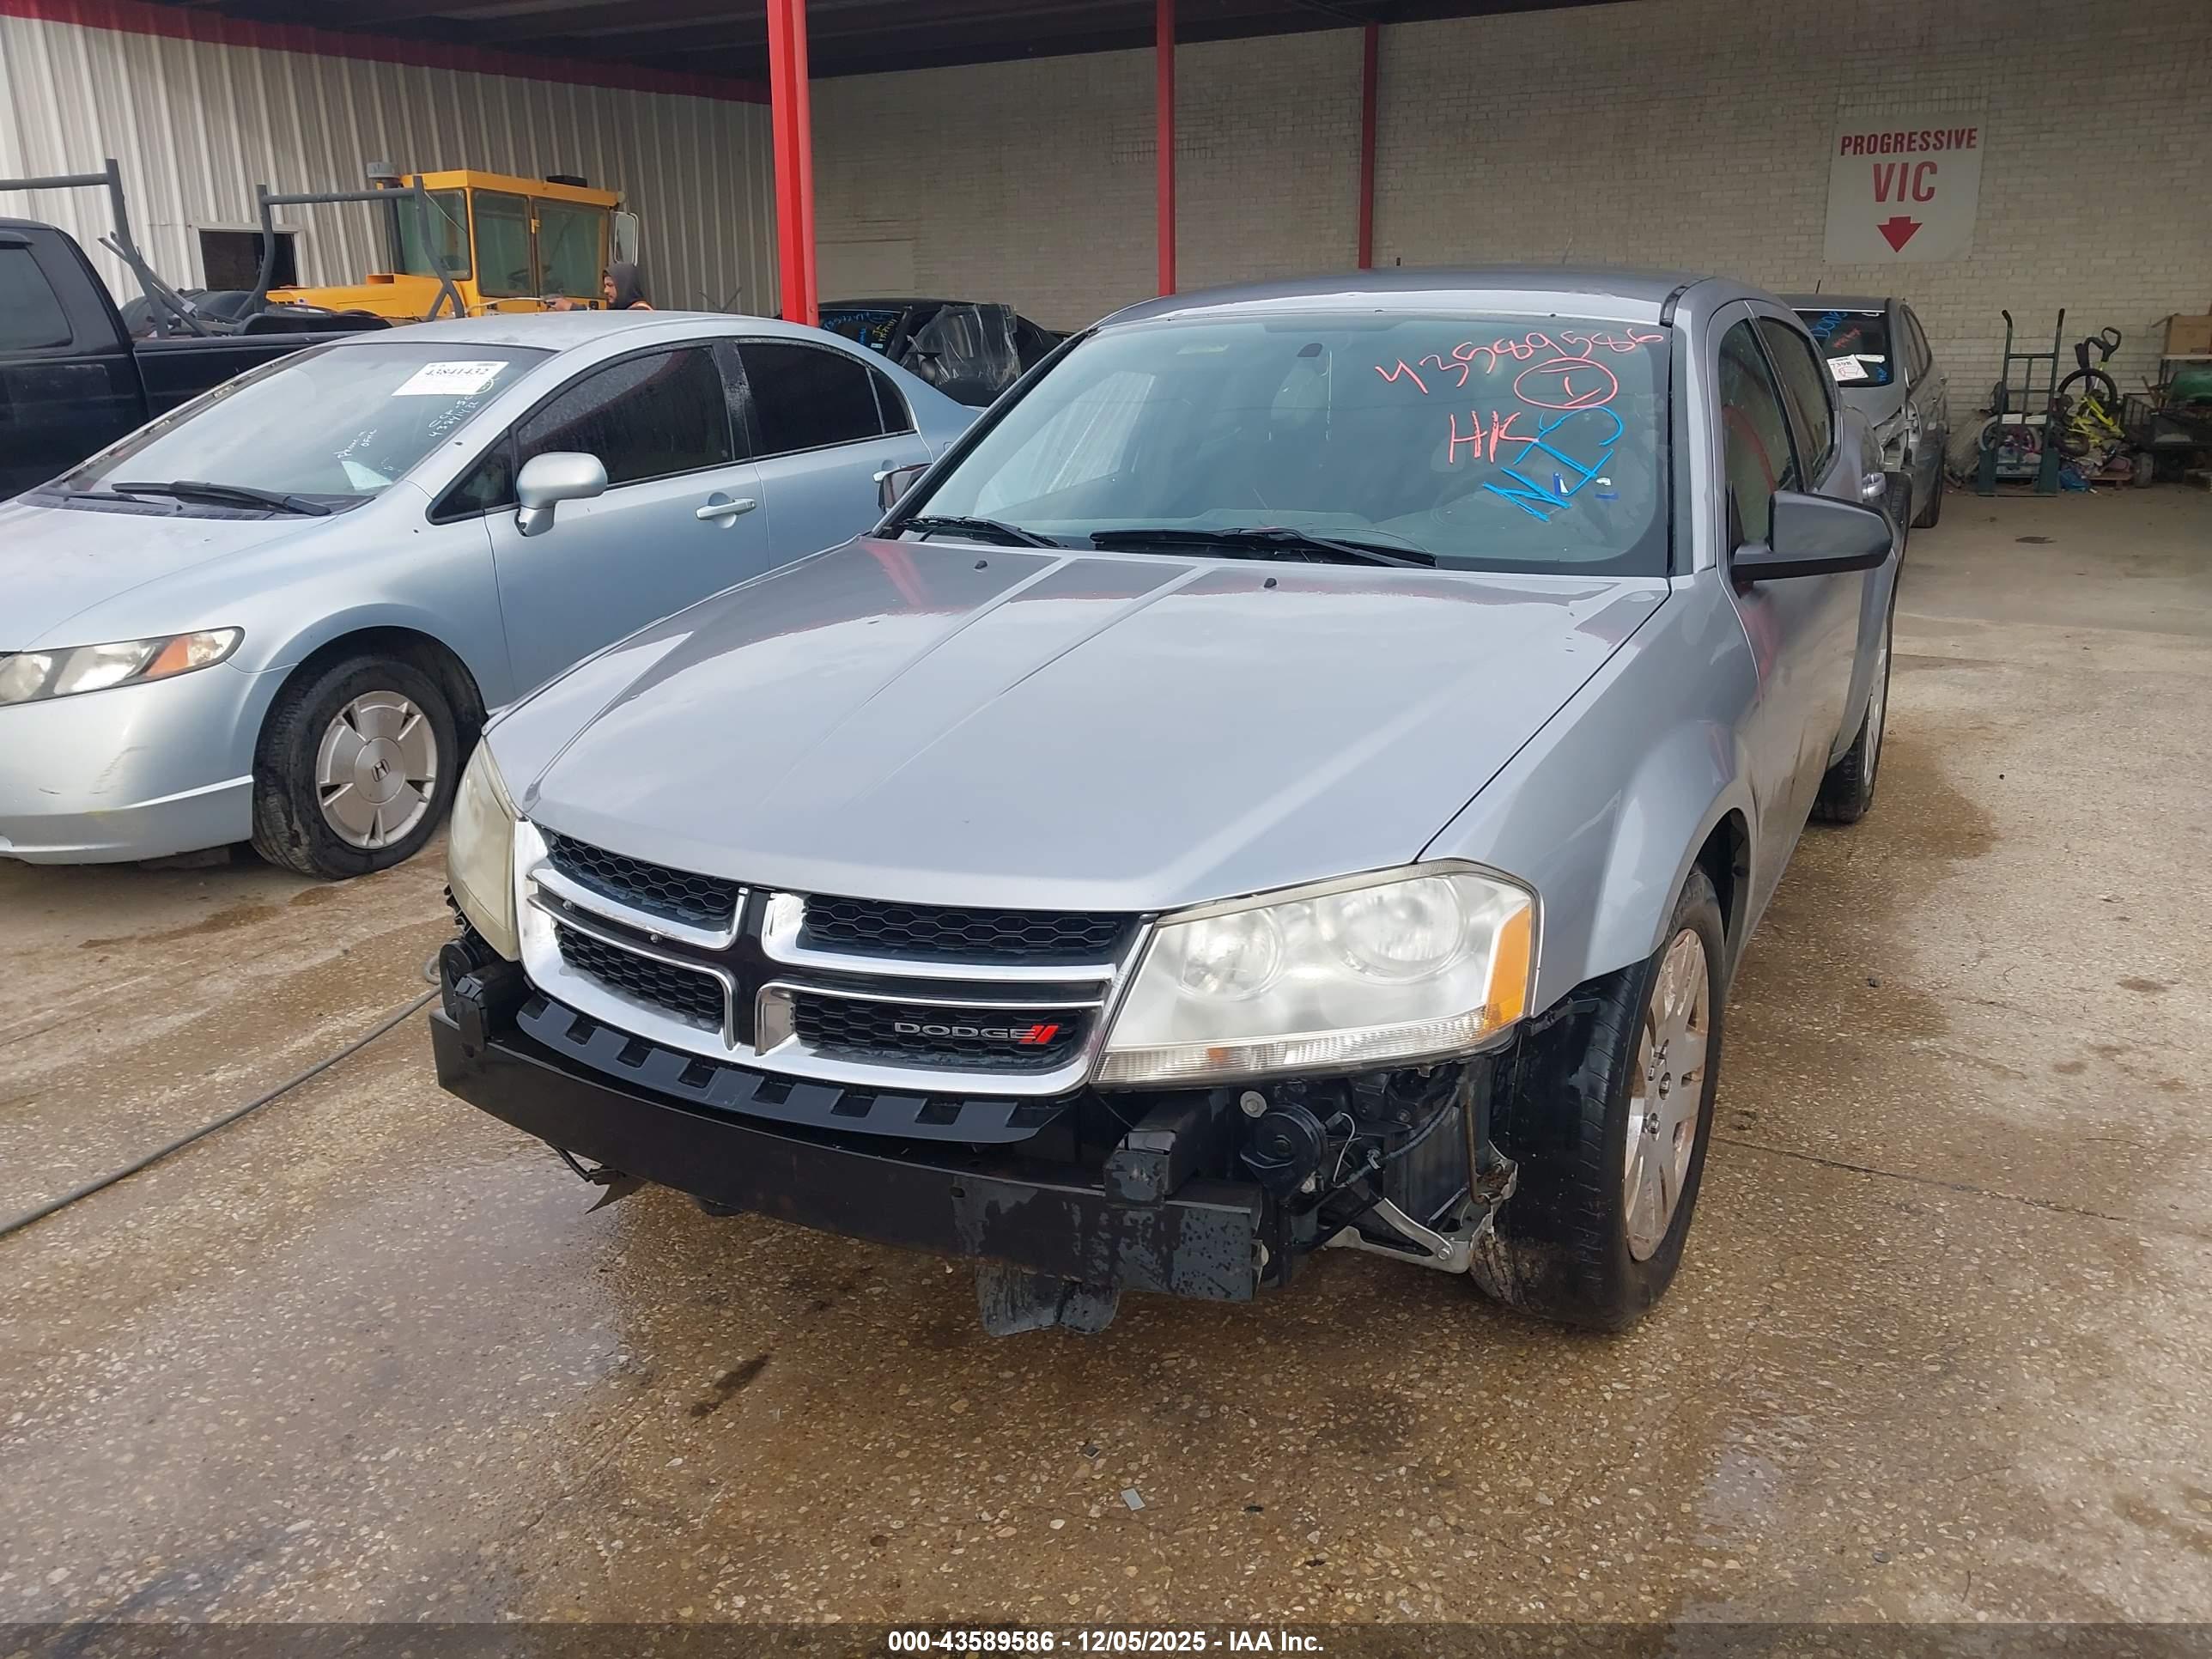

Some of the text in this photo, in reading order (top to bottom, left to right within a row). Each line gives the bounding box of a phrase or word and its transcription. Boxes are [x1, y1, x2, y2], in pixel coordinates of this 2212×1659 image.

[1840, 128, 1978, 156] PROGRESSIVE
[1873, 161, 1938, 203] VIC
[1375, 328, 1664, 395] 43589586
[1449, 410, 1538, 464] HK
[894, 1022, 1036, 1039] DODGE
